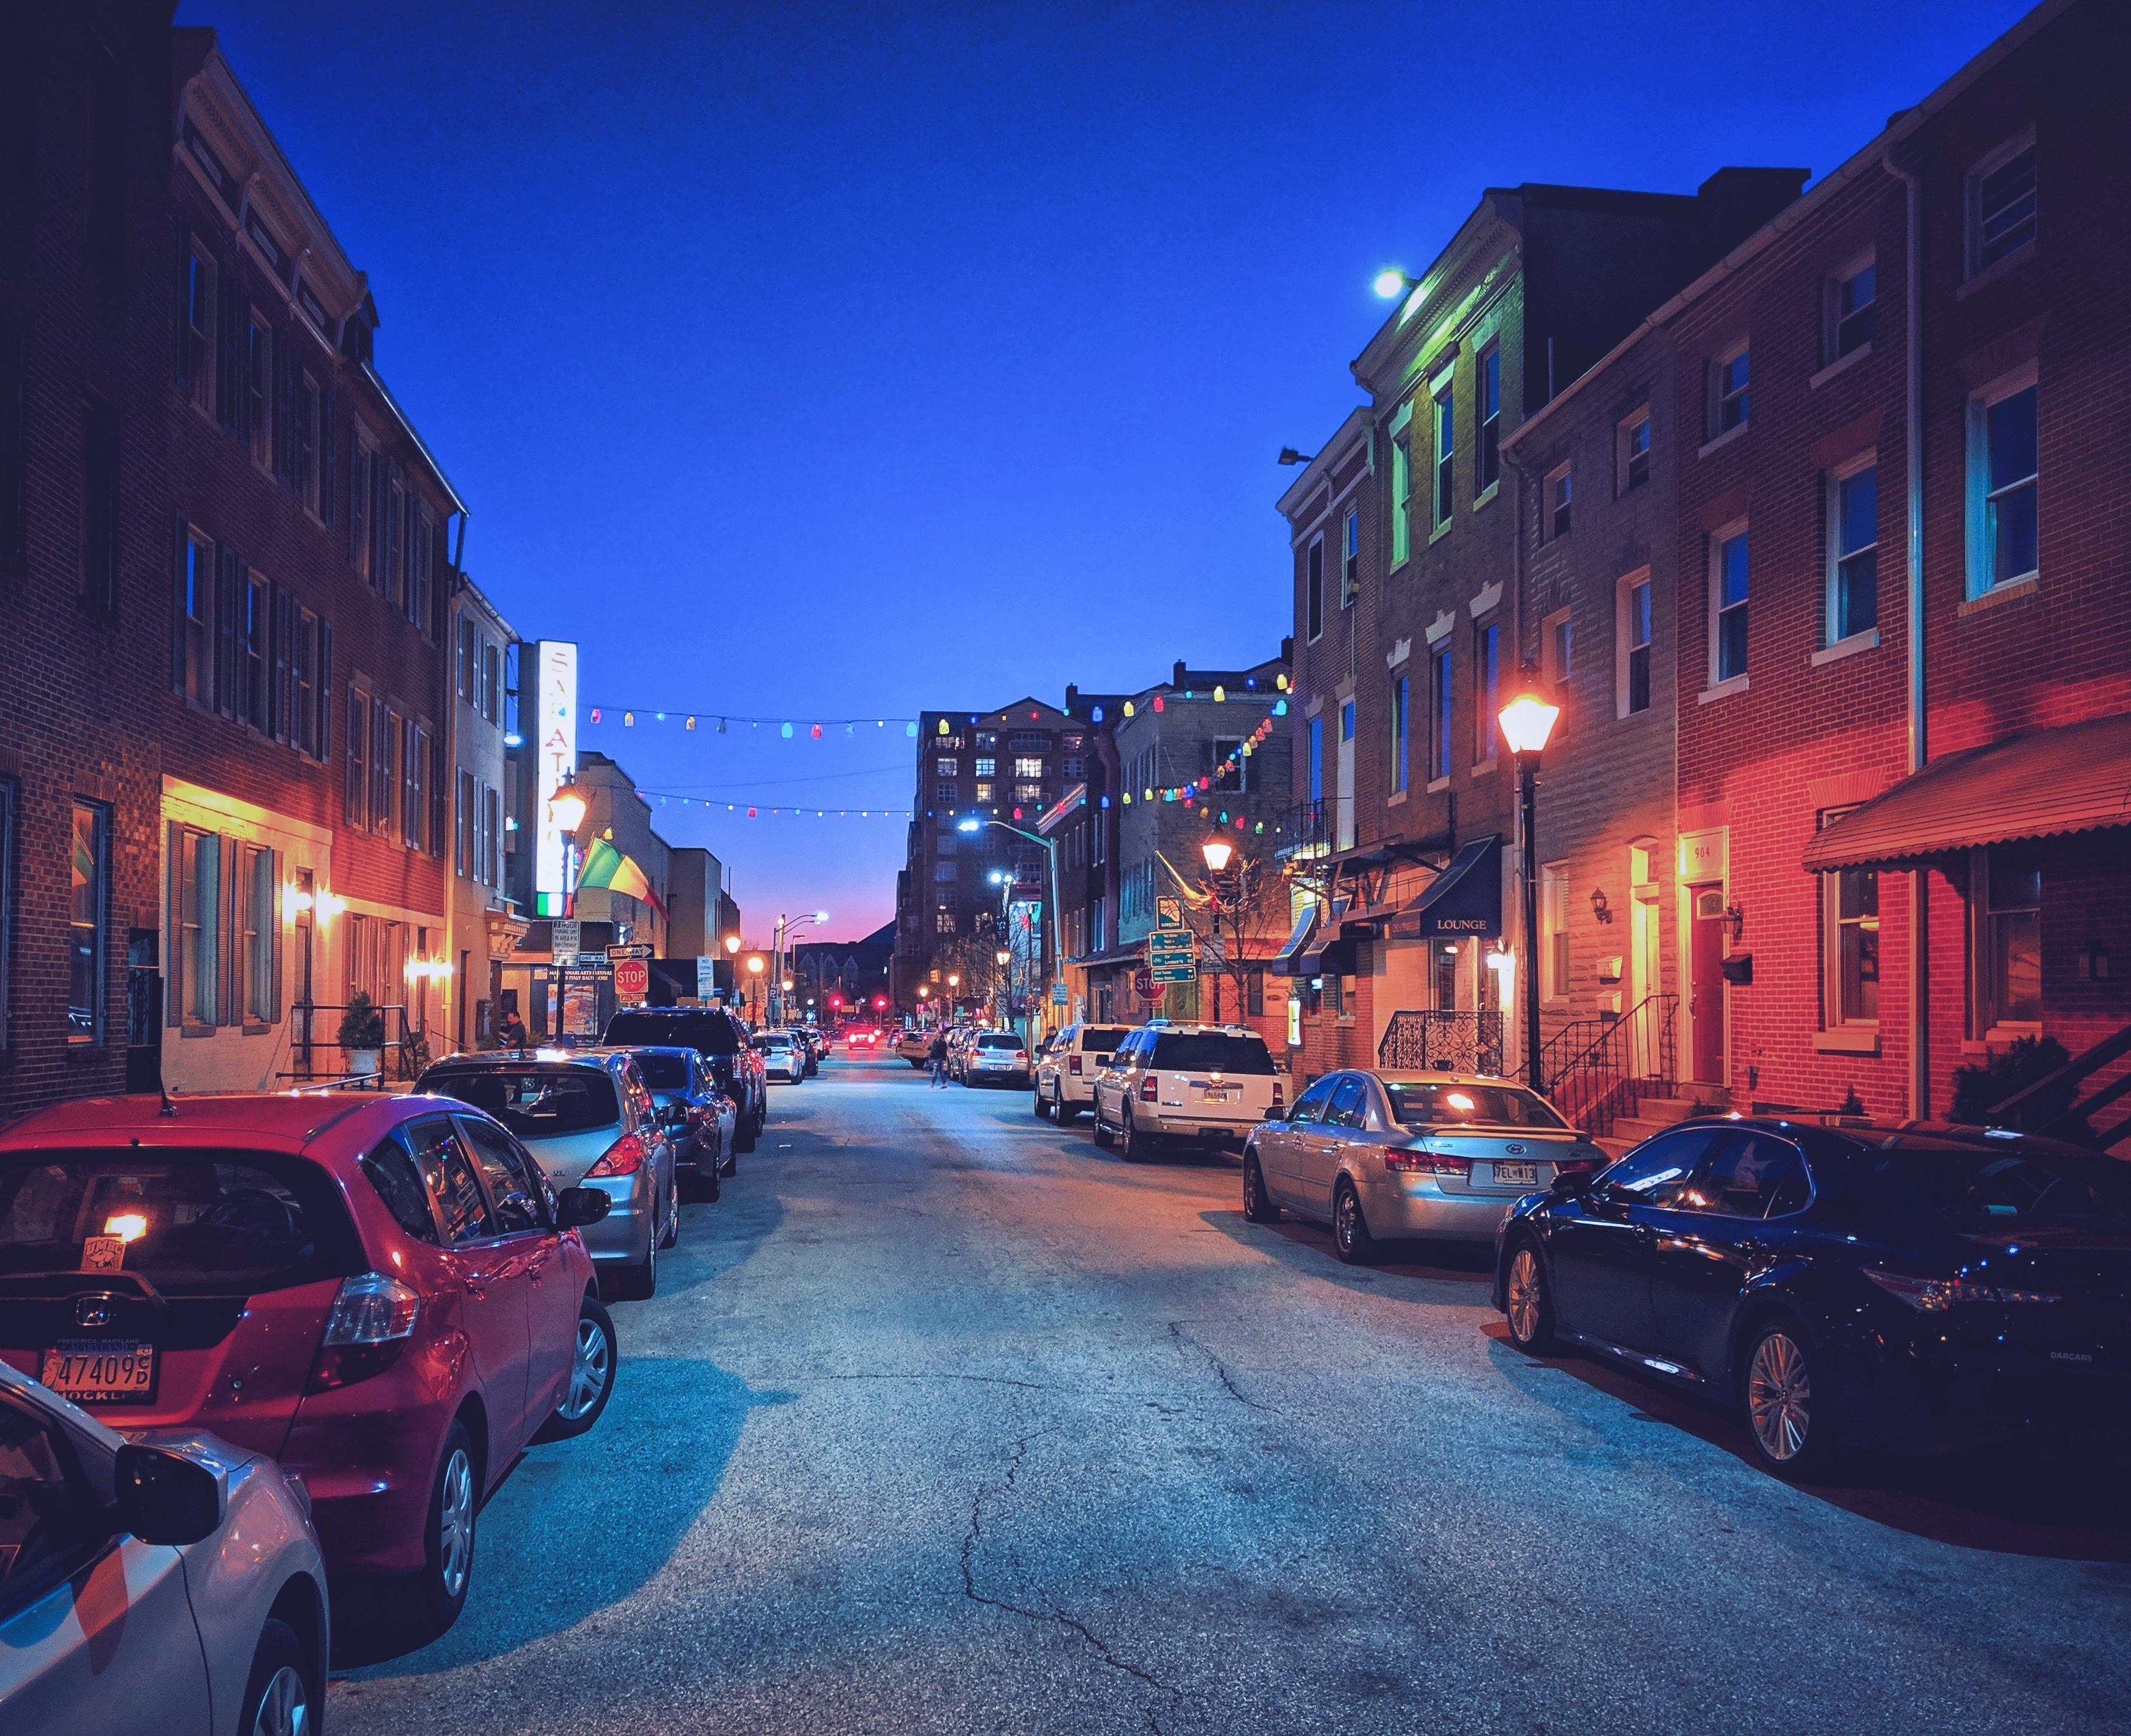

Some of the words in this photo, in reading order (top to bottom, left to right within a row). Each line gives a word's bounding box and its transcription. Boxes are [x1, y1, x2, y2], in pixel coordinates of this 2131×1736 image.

[1695, 846, 1709, 859] 904
[1437, 920, 1486, 929] LOUNGE
[617, 971, 645, 983] STOP
[85, 1239, 124, 1256] UMBC
